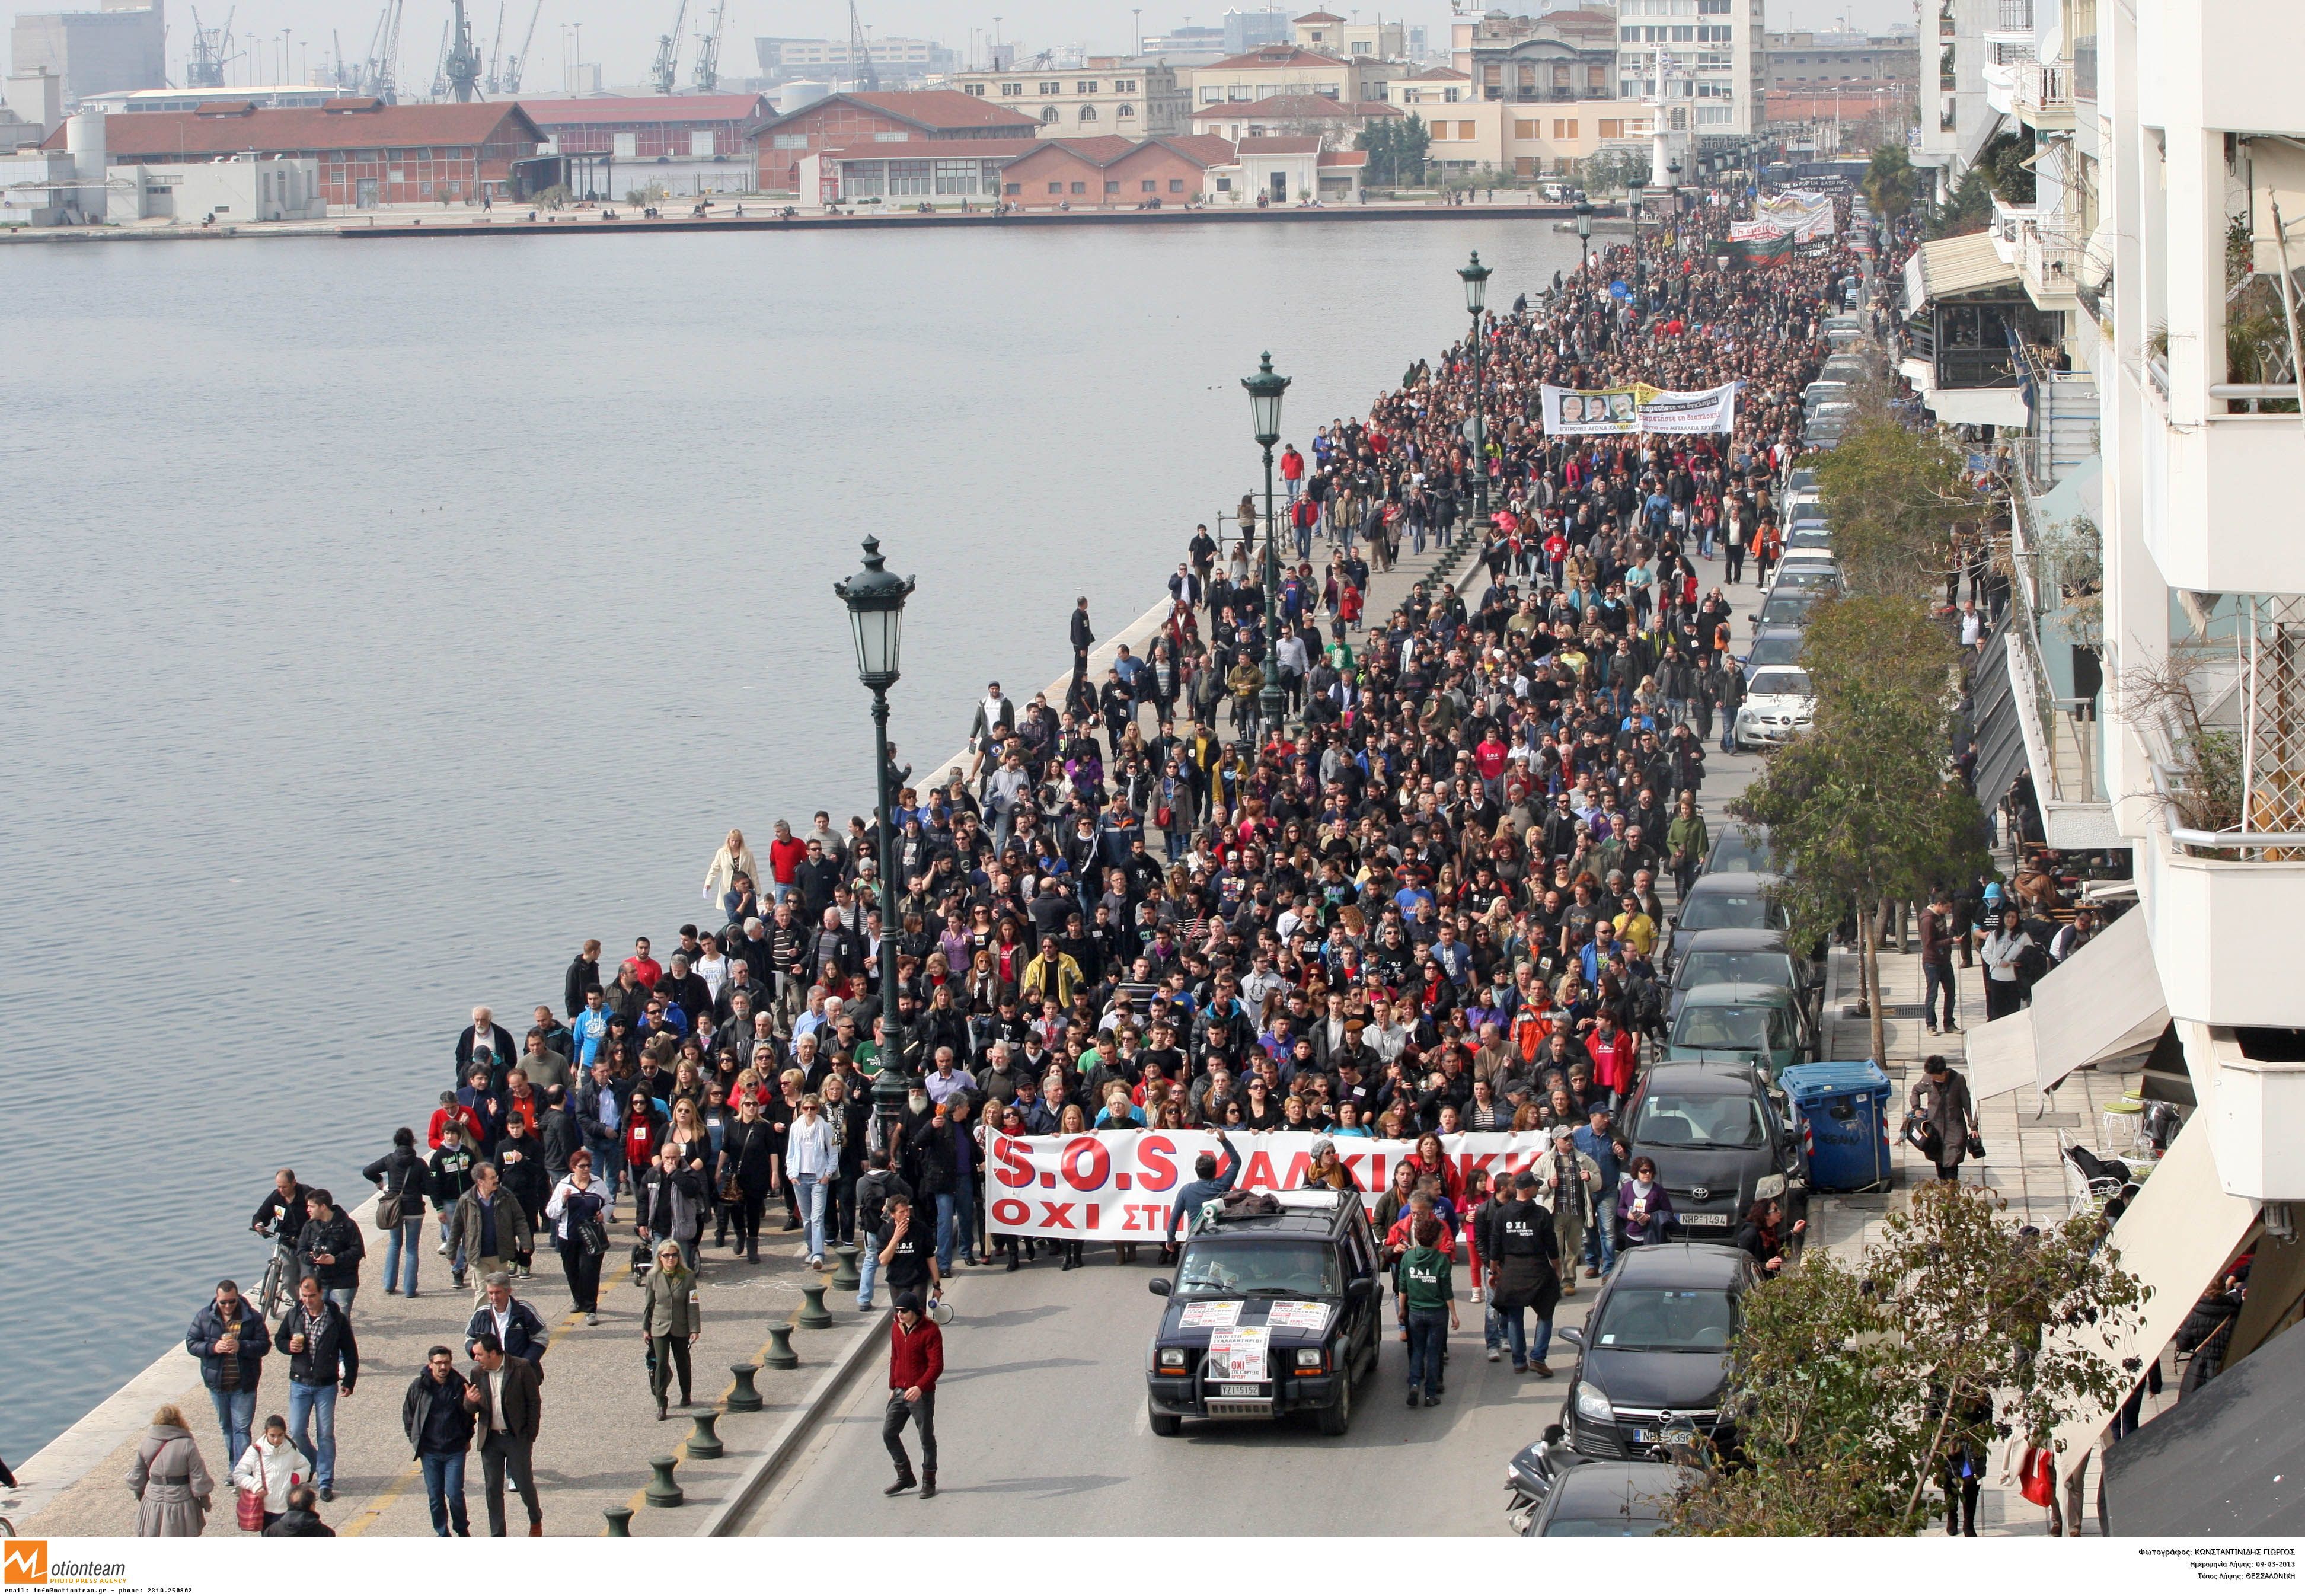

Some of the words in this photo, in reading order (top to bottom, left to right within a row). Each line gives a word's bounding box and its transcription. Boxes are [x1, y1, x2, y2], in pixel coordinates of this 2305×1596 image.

[993, 1135, 1179, 1192] S.O.S
[992, 1198, 1099, 1229] ΟΧΙ
[1231, 1361, 1245, 1370] ΟΧΙ
